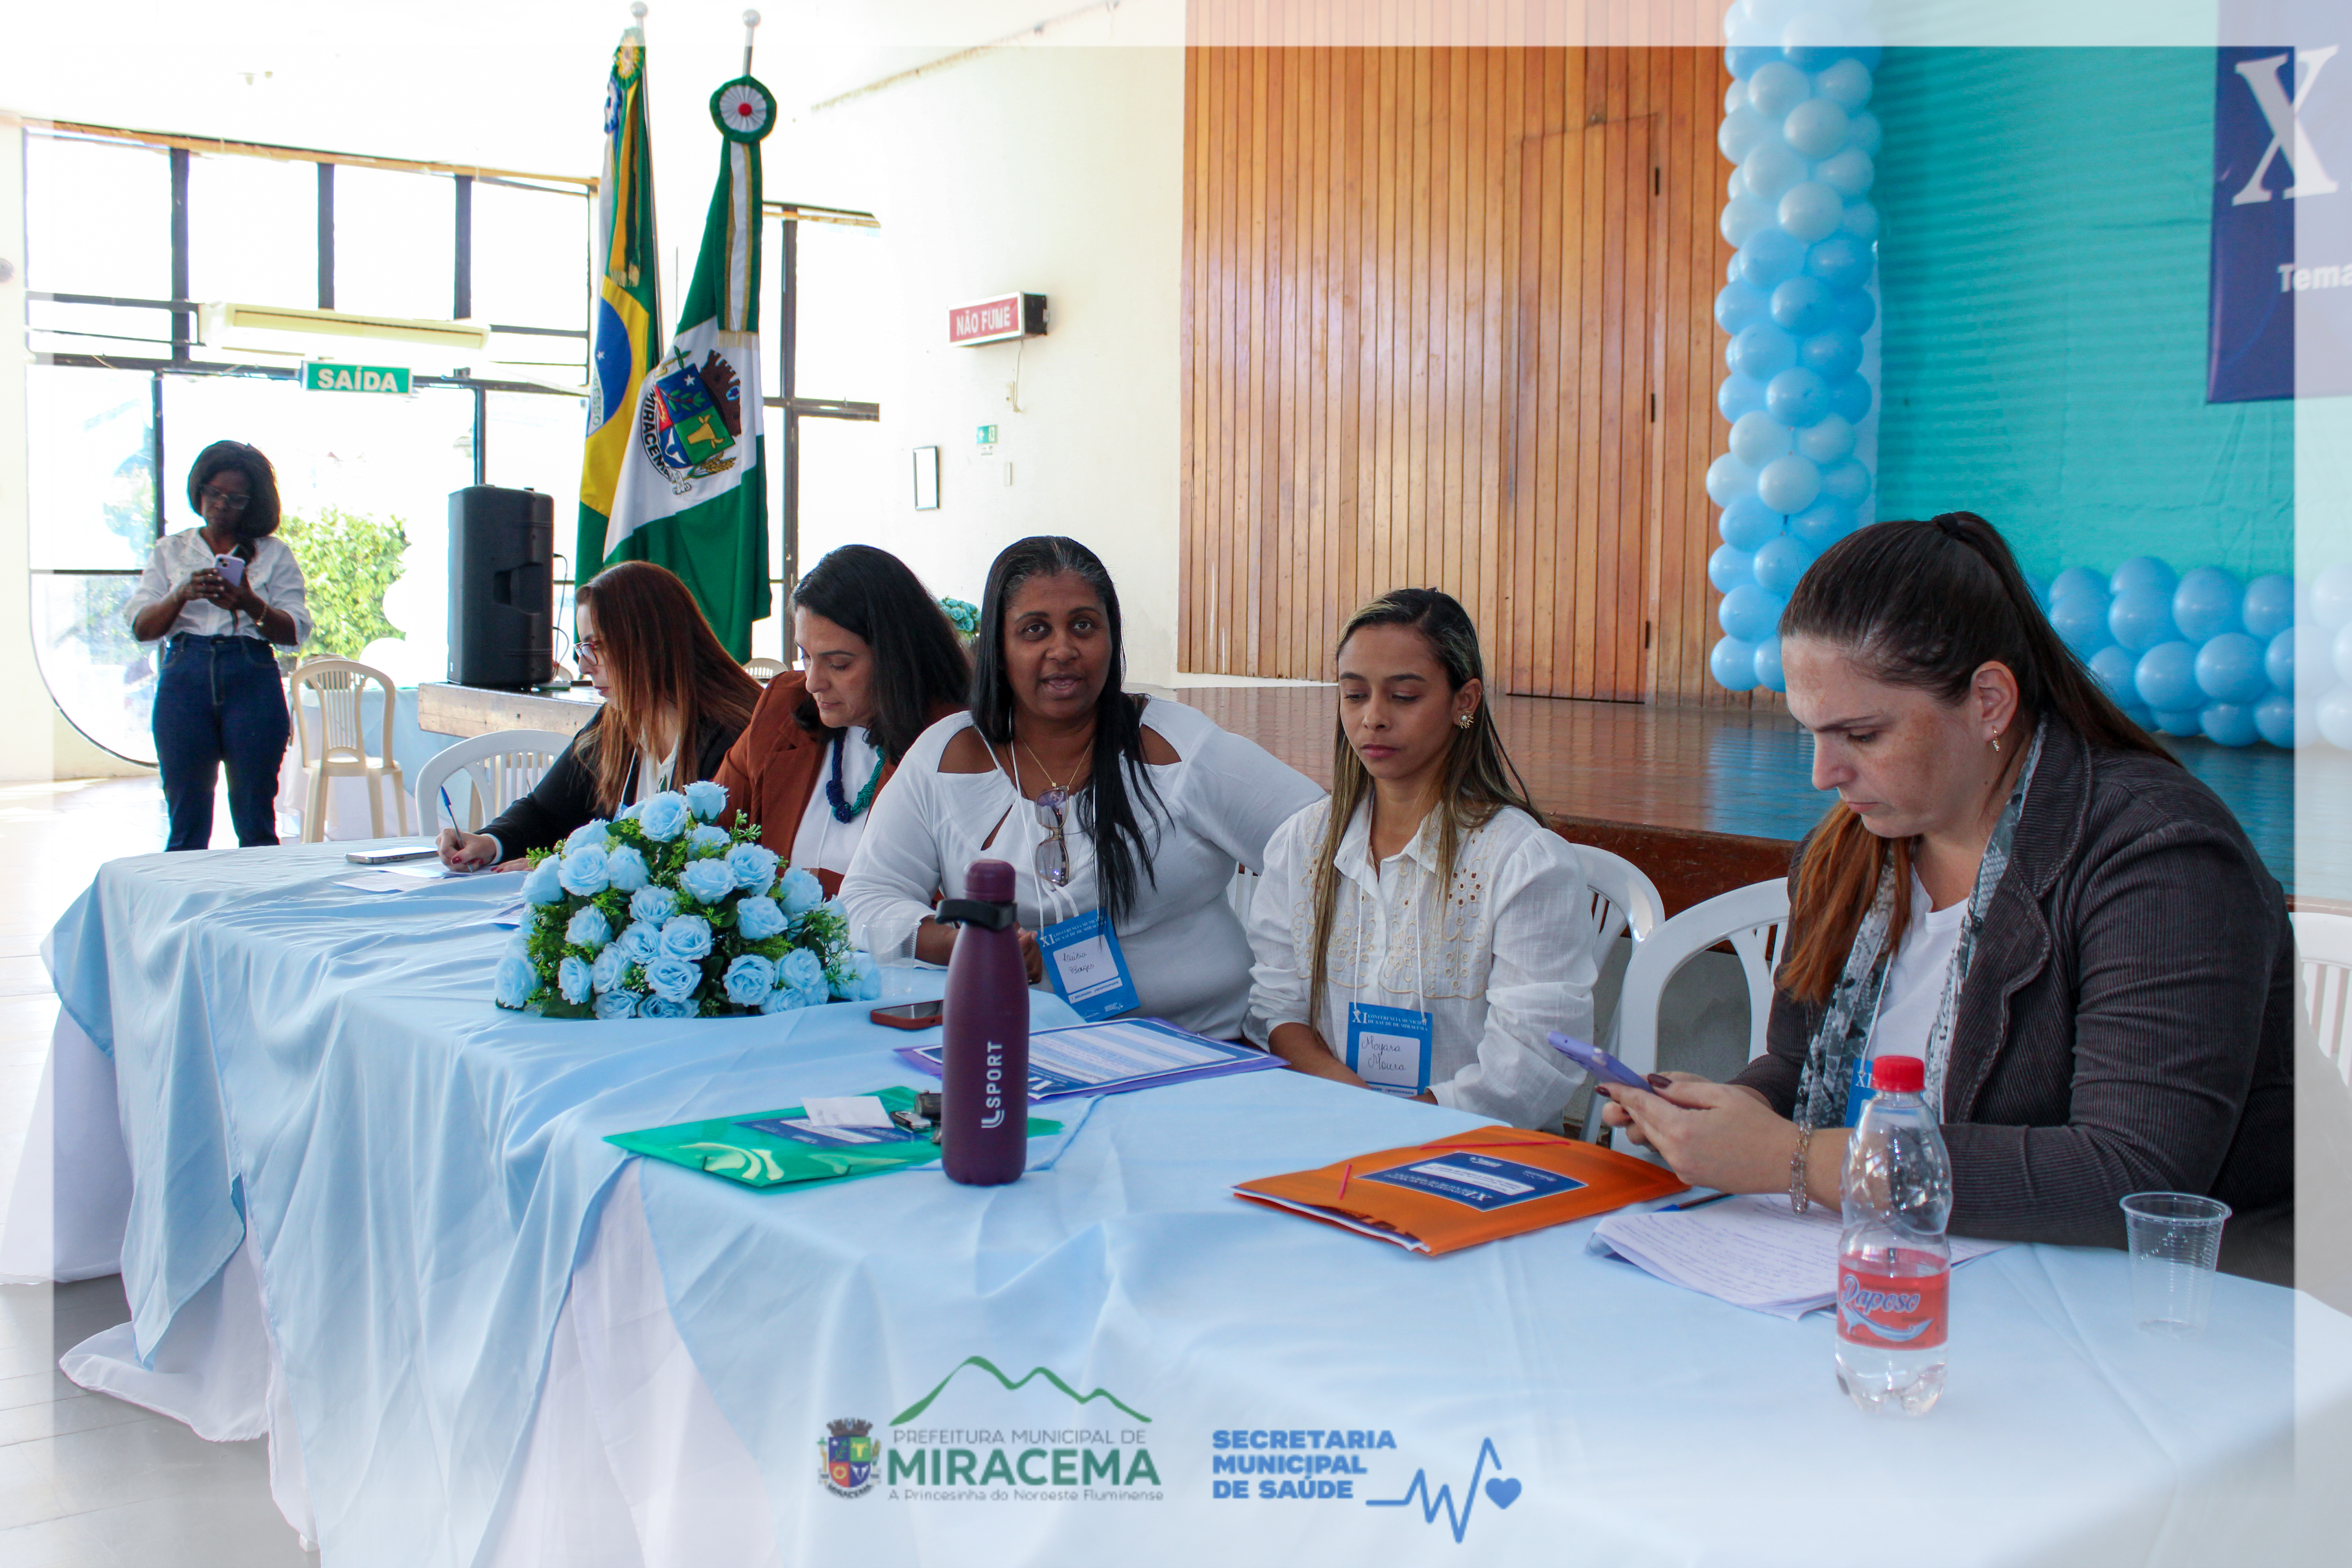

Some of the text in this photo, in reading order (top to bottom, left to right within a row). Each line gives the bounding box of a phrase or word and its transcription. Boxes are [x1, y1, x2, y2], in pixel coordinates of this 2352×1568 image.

[2277, 263, 2352, 293] Tema
[956, 306, 1010, 336] NÃO FUME
[317, 366, 398, 392] SAÍDA
[1352, 1011, 1367, 1024] XI
[1843, 1274, 1920, 1315] Raposo
